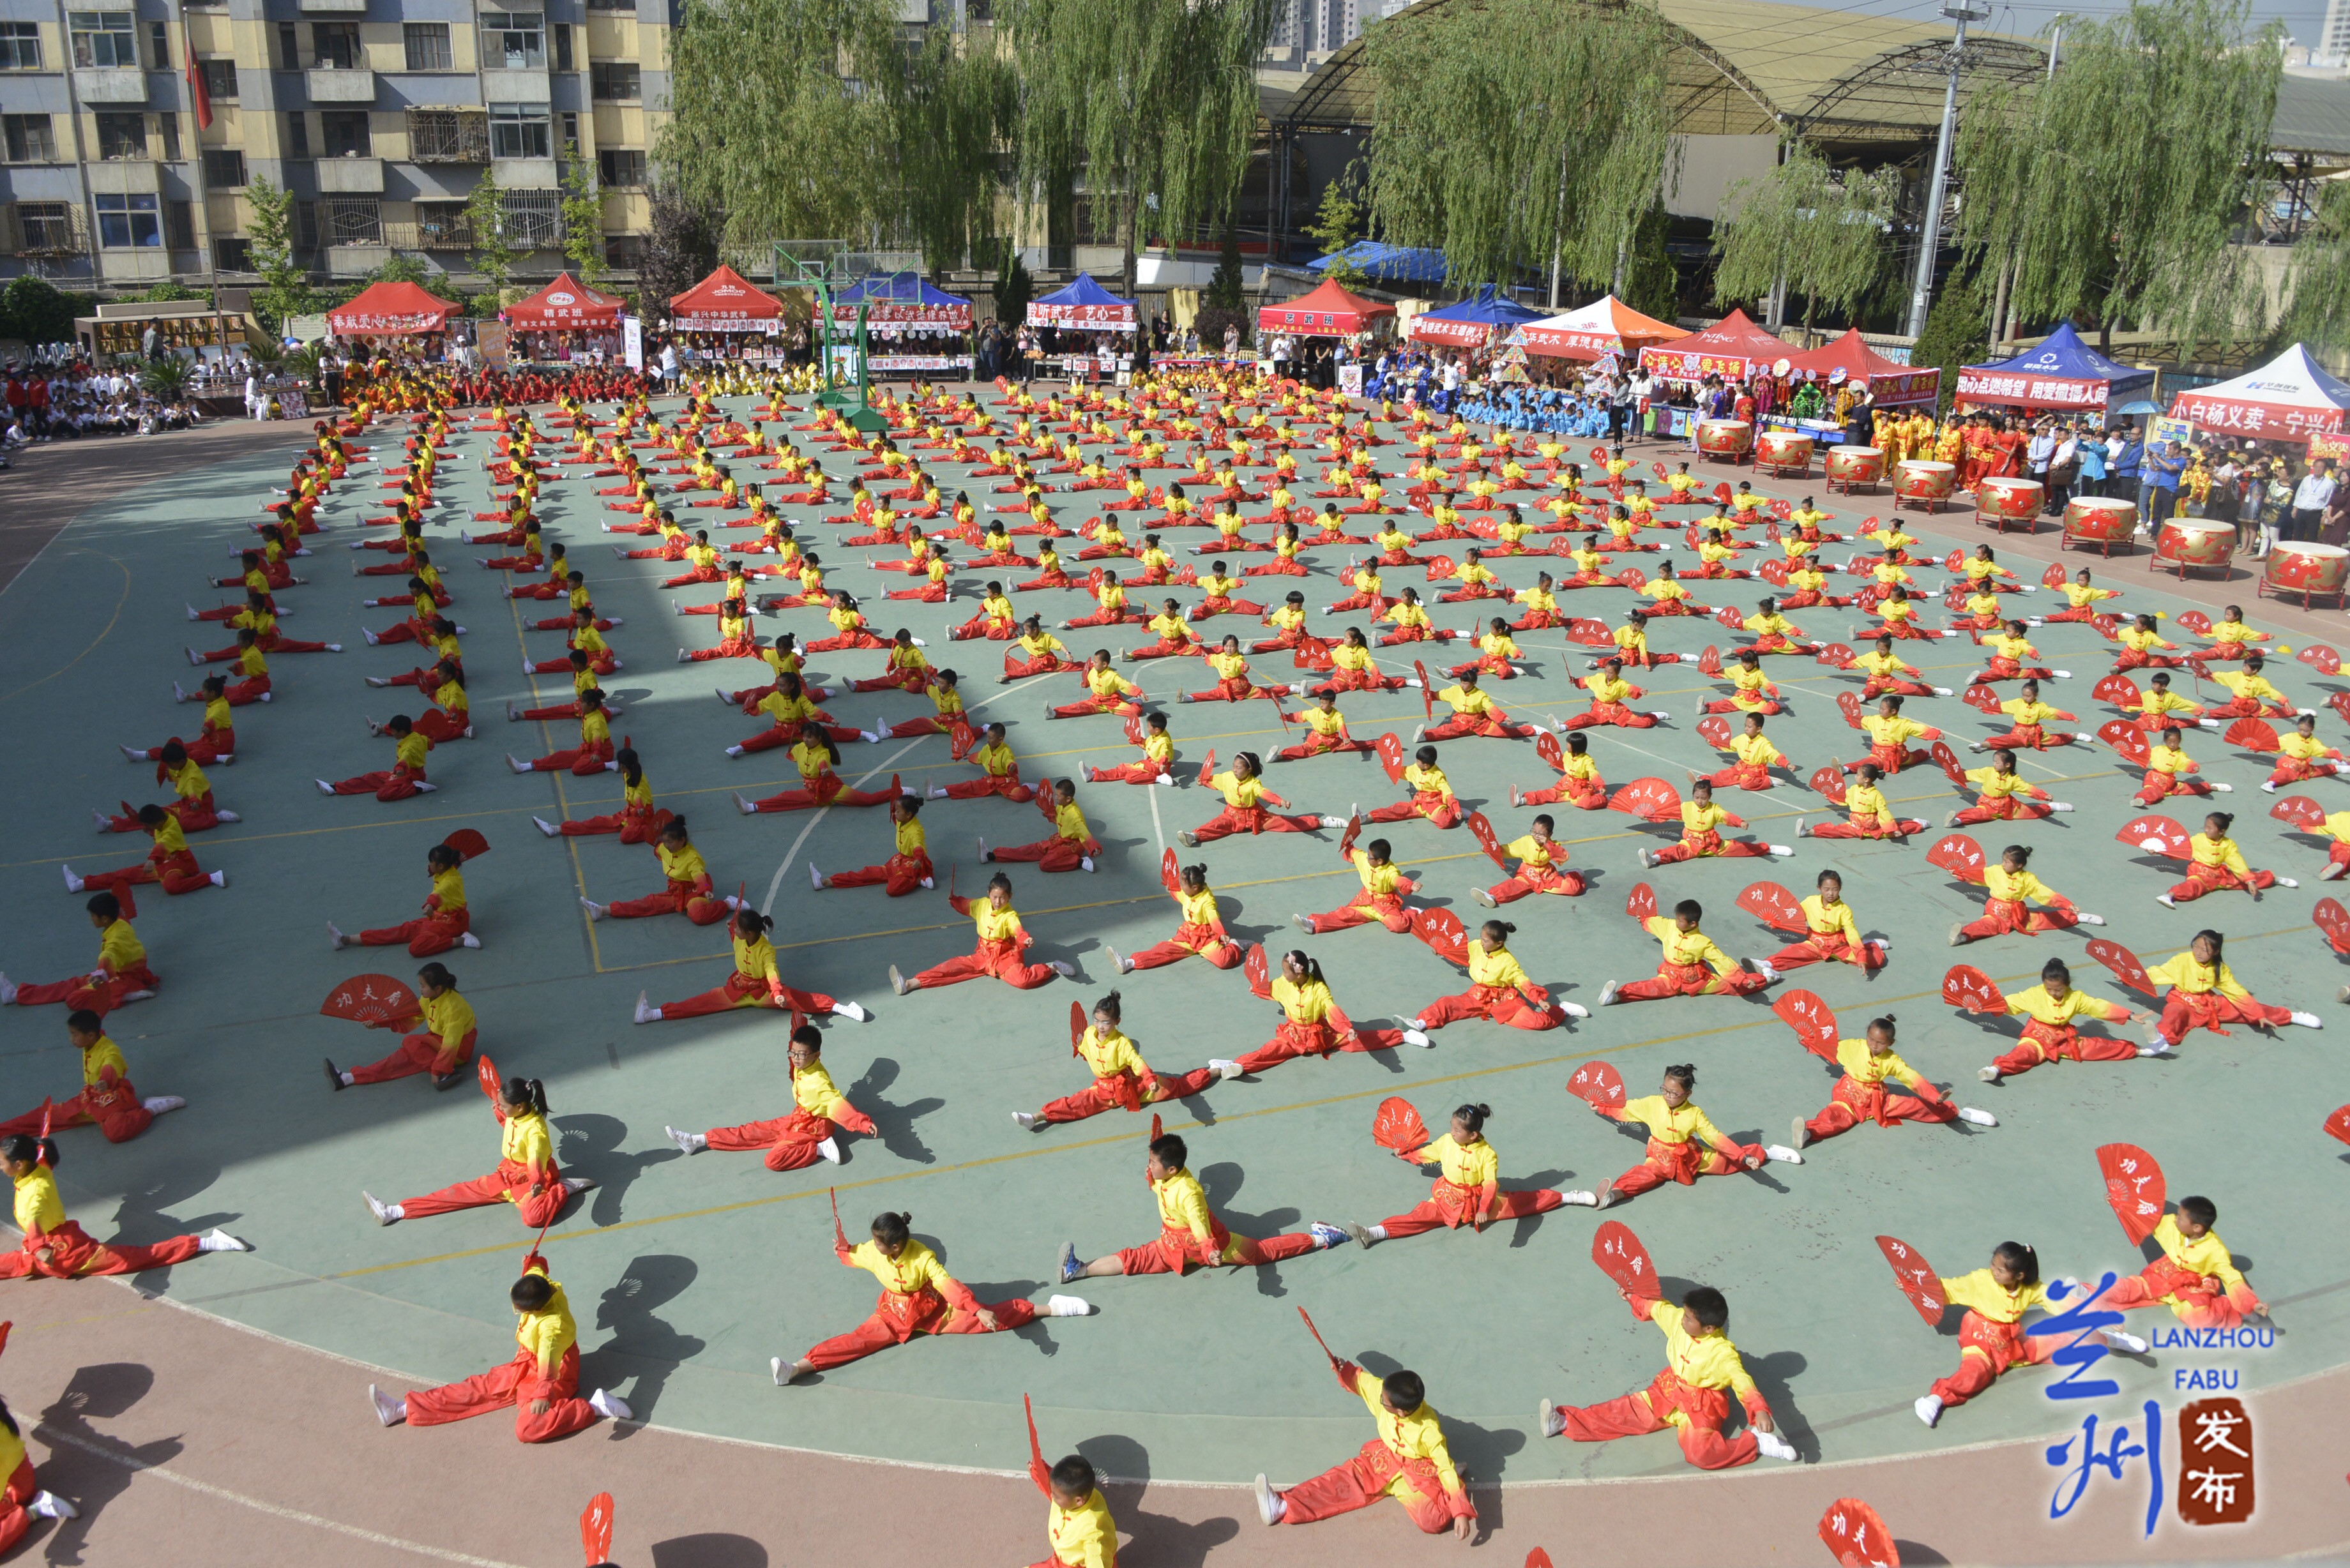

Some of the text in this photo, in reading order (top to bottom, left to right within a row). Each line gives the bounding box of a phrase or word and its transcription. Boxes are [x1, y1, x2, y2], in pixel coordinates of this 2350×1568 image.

[543, 308, 583, 317] 精武班
[1027, 303, 1133, 321] 聆听武艺 艺心一意
[1285, 313, 1334, 325] 艺武班
[1449, 324, 1483, 338] 立德树人
[1524, 332, 1560, 345] 华武术
[1701, 358, 1741, 375] 爱飞扬
[1956, 376, 2026, 398] 用心点燃希望
[2029, 381, 2109, 404] 用爱撒播人间
[1575, 625, 1609, 640] 功夫扇
[2180, 615, 2210, 629] 功夫扇
[1300, 646, 1327, 660] 功夫扇
[1821, 646, 1852, 660] 功夫扇
[2303, 649, 2337, 665] 功夫扇
[1967, 688, 1997, 705] 功夫扇
[2104, 681, 2134, 696] 功夫扇
[1702, 720, 1730, 741] 功夫扇
[2111, 726, 2144, 753] 功夫扇
[1384, 737, 1400, 765] 功夫扇
[1938, 748, 1959, 773] 功夫扇
[1817, 771, 1844, 791] 功夫扇
[1630, 785, 1669, 803] 功夫扇
[2278, 801, 2322, 821] 功夫扇
[2133, 822, 2185, 847] 功夫扇
[1943, 841, 1981, 864] 功夫扇
[1629, 891, 1654, 911] 功夫扇
[1750, 889, 1796, 919] 功夫扇
[2319, 907, 2350, 933] 功夫扇
[1427, 919, 1464, 946] 功夫扇
[2094, 944, 2142, 979] 功夫扇
[337, 983, 402, 1007] 功夫扇
[1948, 975, 1989, 1000] 功夫扇
[1793, 1000, 1835, 1040] 功夫扇
[1575, 1069, 1622, 1099] 功夫扇
[2119, 1157, 2158, 1216] 功夫扇
[1604, 1236, 1643, 1276] 功夫扇
[1891, 1242, 1939, 1310] 功夫扇
